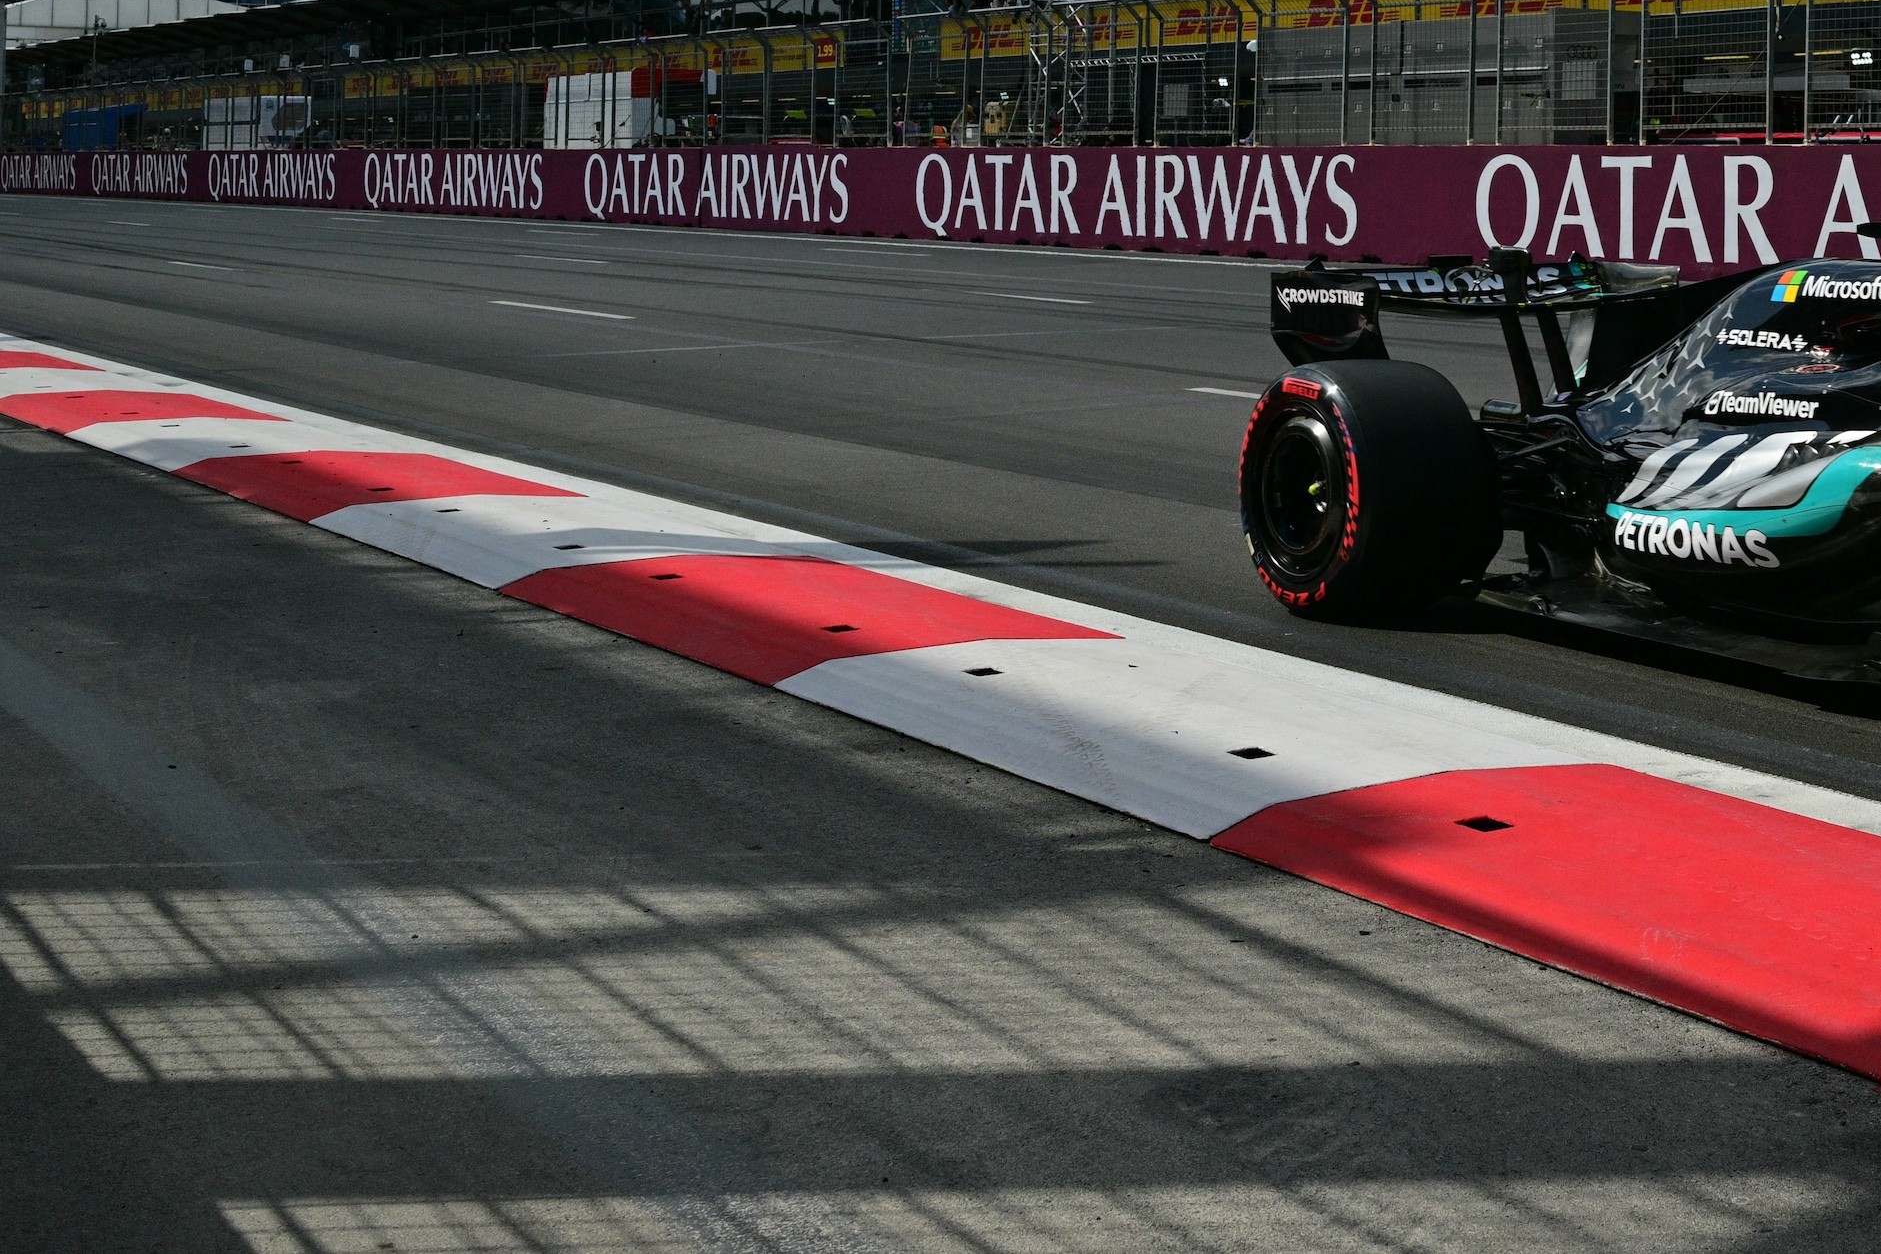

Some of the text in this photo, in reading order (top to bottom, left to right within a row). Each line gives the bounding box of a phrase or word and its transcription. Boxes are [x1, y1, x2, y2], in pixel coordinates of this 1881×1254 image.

[961, 23, 1014, 50] DHL
[1176, 6, 1238, 36] DHL
[0, 155, 76, 191] QATAR AIRWAYS
[92, 154, 188, 194] QATAR AIRWAYS
[208, 153, 336, 201] QATAR AIRWAYS
[365, 153, 543, 210] QATAR AIRWAYS
[584, 153, 849, 223] QATAR AIRWAYS
[915, 153, 1358, 246] QATAR AIRWAYS
[1475, 154, 1780, 266] QATAR
[1283, 288, 1364, 308] CROWDSTRIKE
[1729, 329, 1792, 351] SOLERA
[1721, 392, 1819, 418] TeamViewer
[1614, 509, 1781, 569] PETRONAS
[1257, 566, 1311, 608] ZERO
